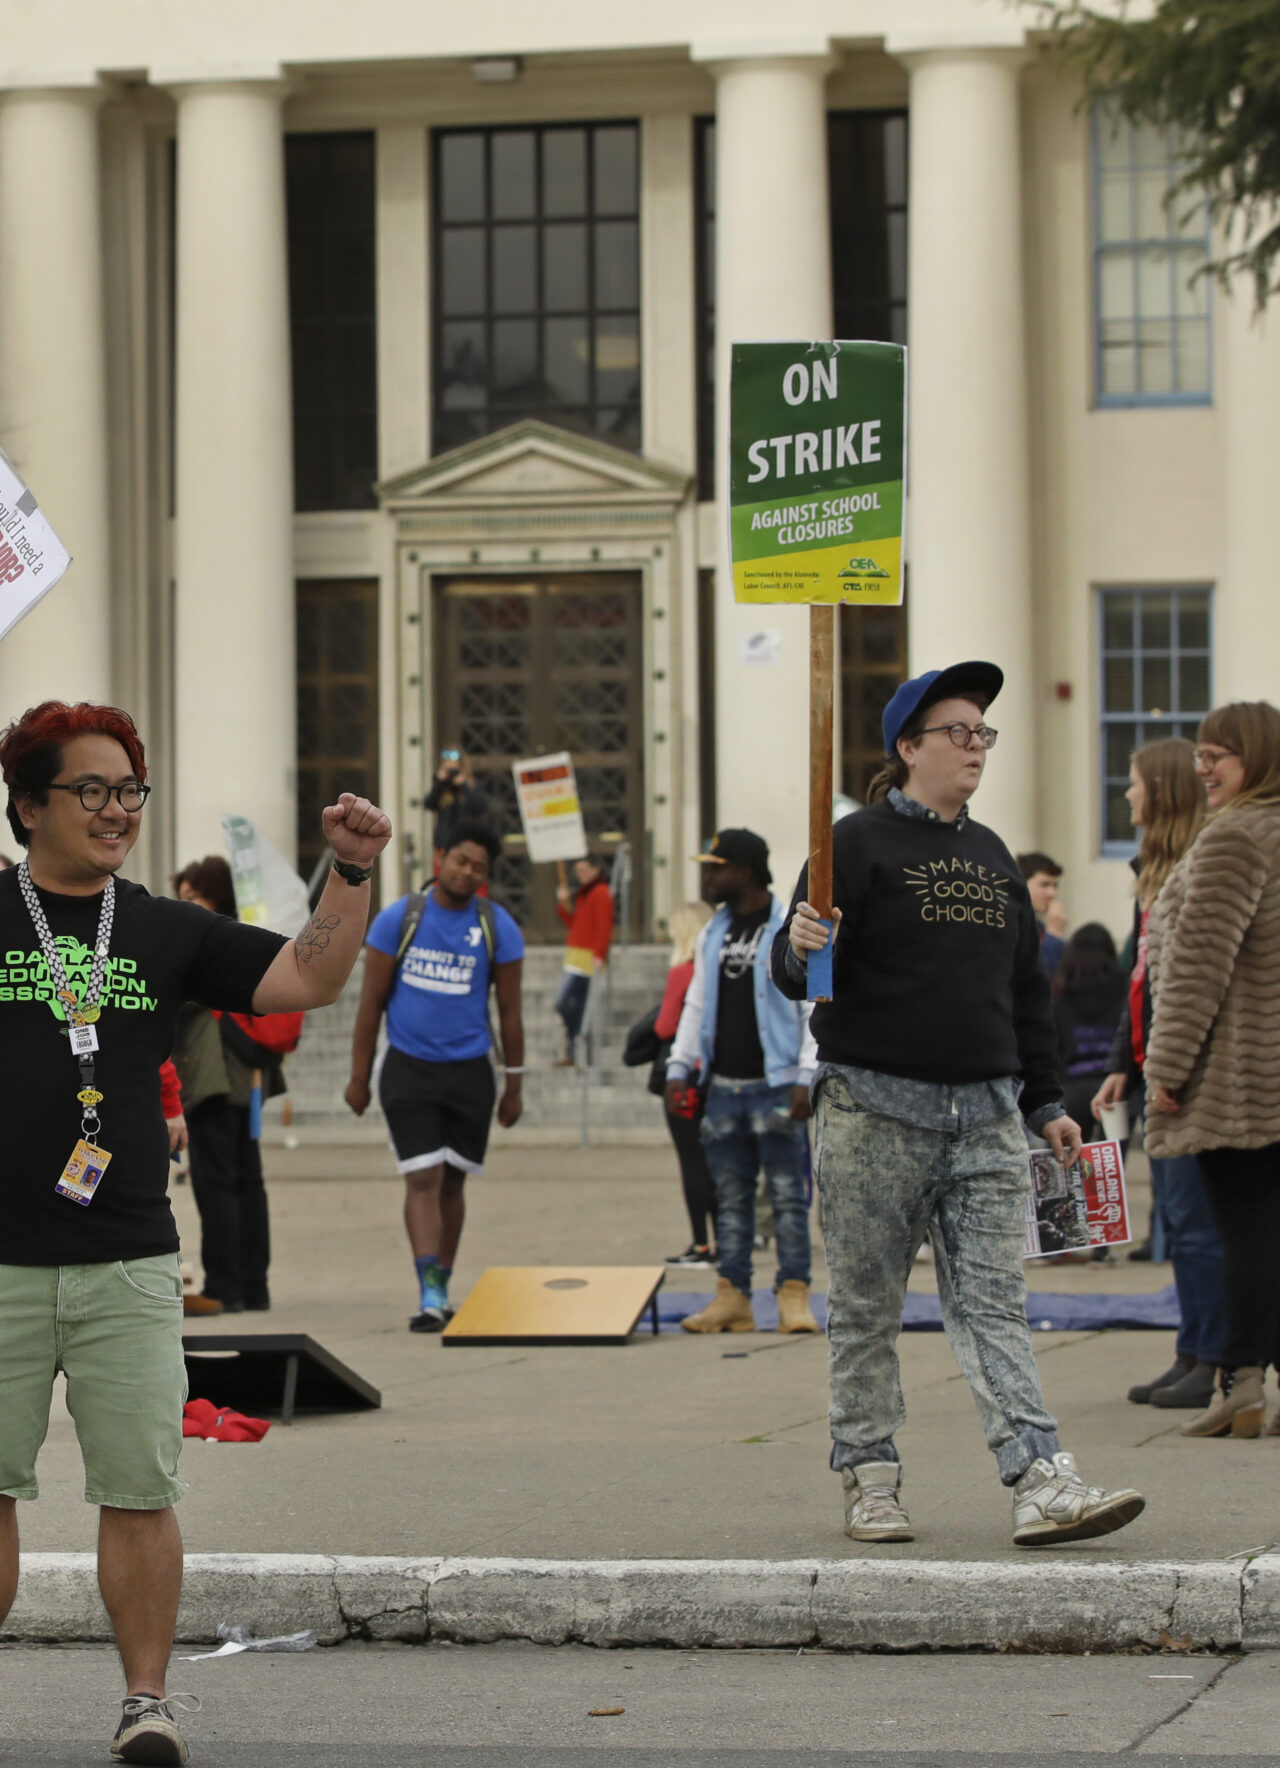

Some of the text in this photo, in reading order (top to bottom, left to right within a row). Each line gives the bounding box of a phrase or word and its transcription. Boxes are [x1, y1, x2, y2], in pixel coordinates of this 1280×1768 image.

[782, 357, 838, 406] ON
[747, 420, 881, 483] STRIKE
[751, 492, 881, 531] AGAINST SCHOOL
[10, 525, 26, 540] I
[777, 515, 854, 545] CLOSURES
[15, 535, 44, 567] need
[32, 563, 44, 576] a
[776, 571, 782, 579] by
[848, 558, 878, 570] OEA
[929, 857, 987, 881] MAKE
[934, 880, 993, 902] GOOD
[921, 904, 1006, 928] CHOICES
[6, 951, 137, 973] OALAND
[402, 958, 473, 982] CHANGE
[458, 955, 477, 968] TO
[1091, 1147, 1106, 1203] STRIKE NEWS
[1102, 1145, 1120, 1203] OAKLAND
